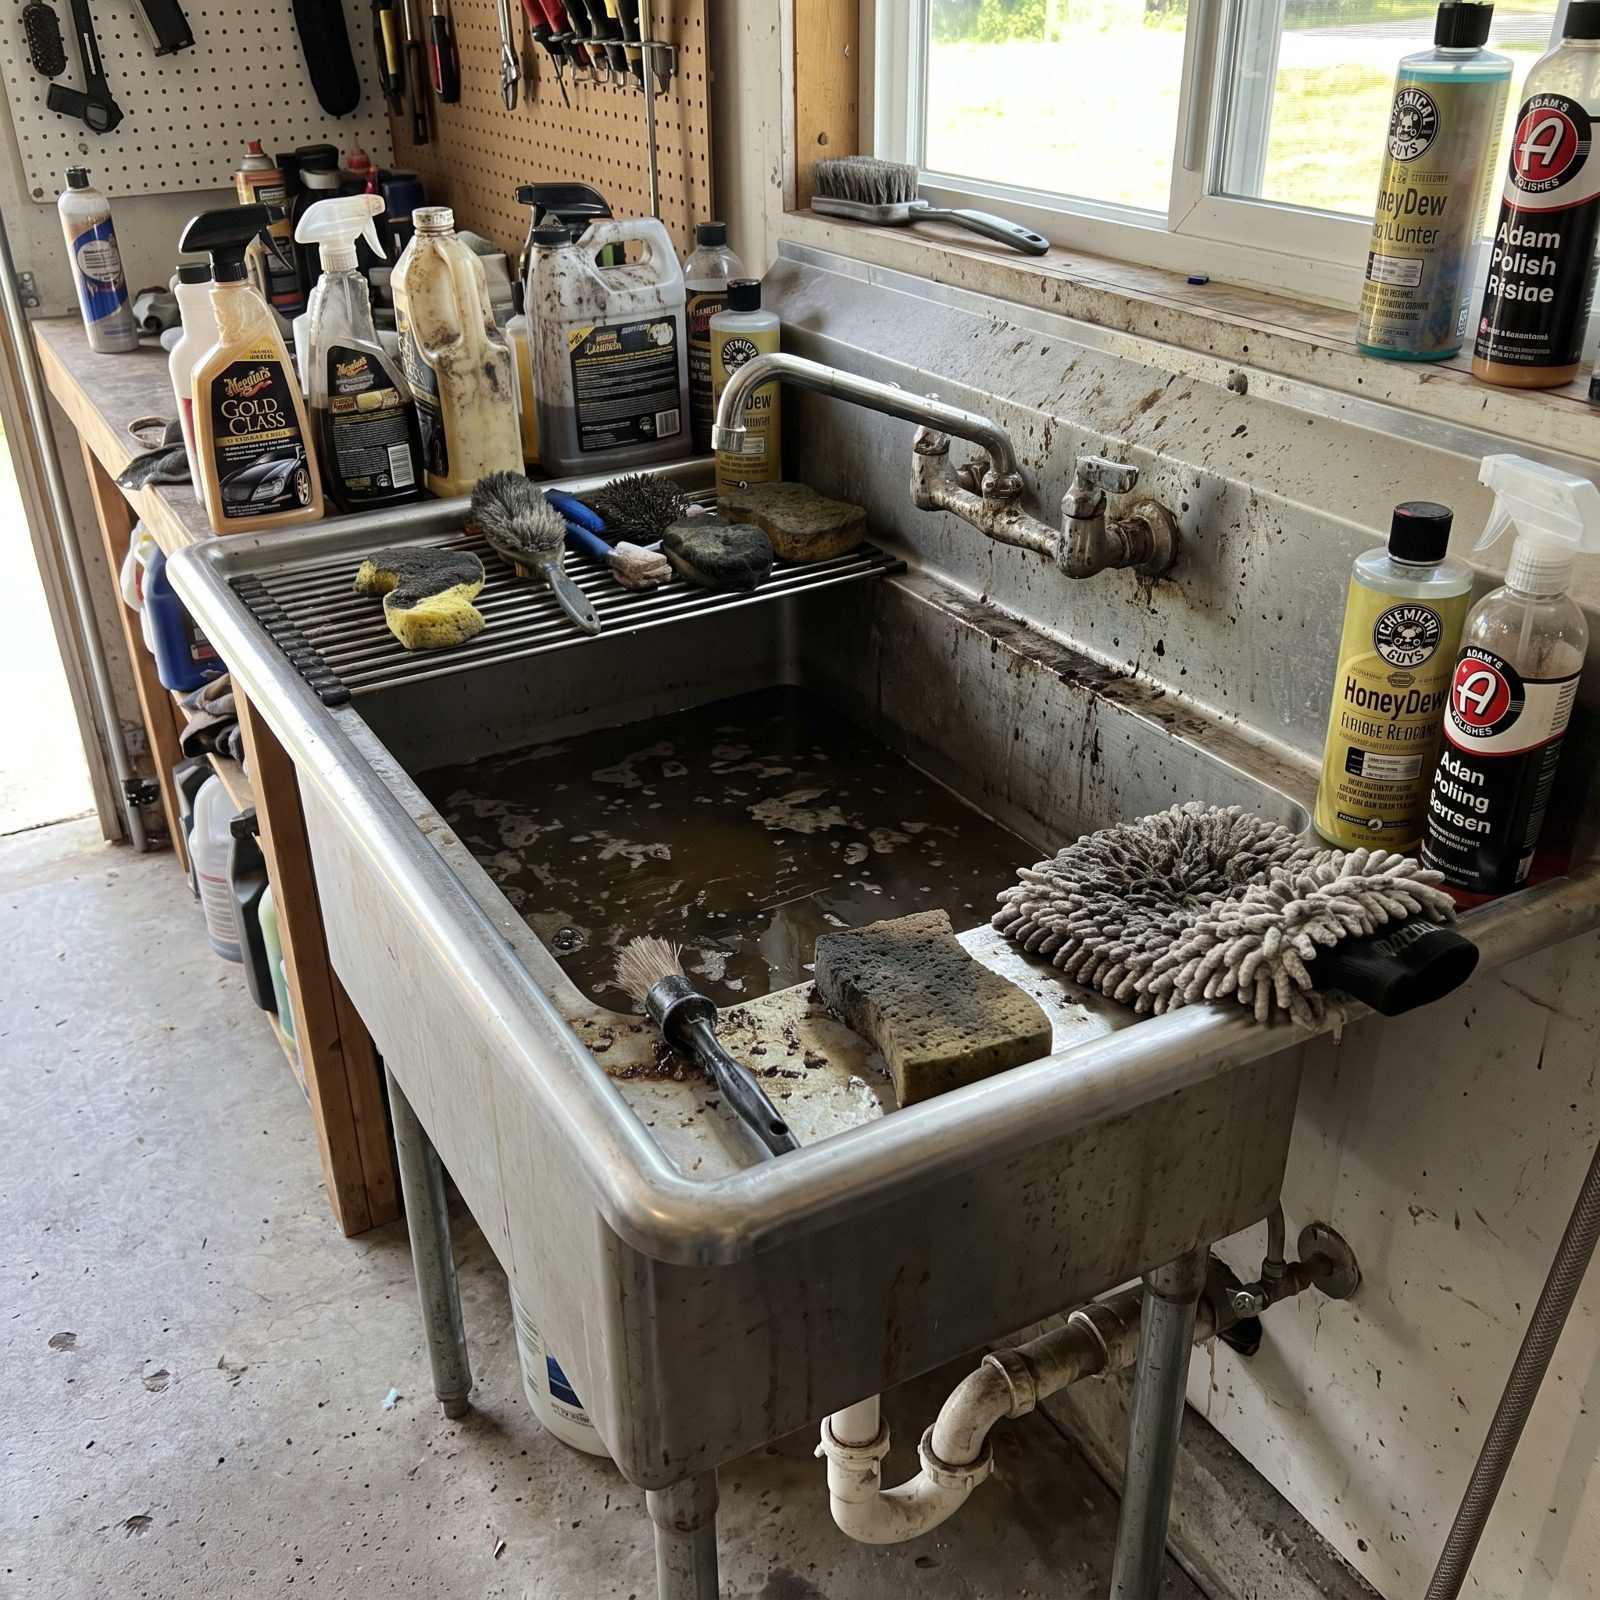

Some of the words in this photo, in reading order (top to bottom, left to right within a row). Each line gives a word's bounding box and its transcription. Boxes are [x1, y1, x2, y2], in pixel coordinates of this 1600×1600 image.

[1529, 98, 1570, 112] ADAM'S
[1518, 117, 1564, 171] A
[1497, 221, 1561, 249] Adam
[1491, 247, 1557, 276] Polish
[221, 398, 278, 419] GOLD
[229, 411, 286, 436] CLASS
[1378, 609, 1438, 638] CHEMICAL
[1386, 648, 1424, 664] GUYS
[1467, 648, 1503, 670] ADAM'S
[1344, 675, 1447, 721] HoneyDew
[1456, 671, 1497, 715] A
[1452, 710, 1493, 736] POLISHES
[1440, 751, 1485, 786] Adan
[1430, 788, 1491, 834] Serrsen
